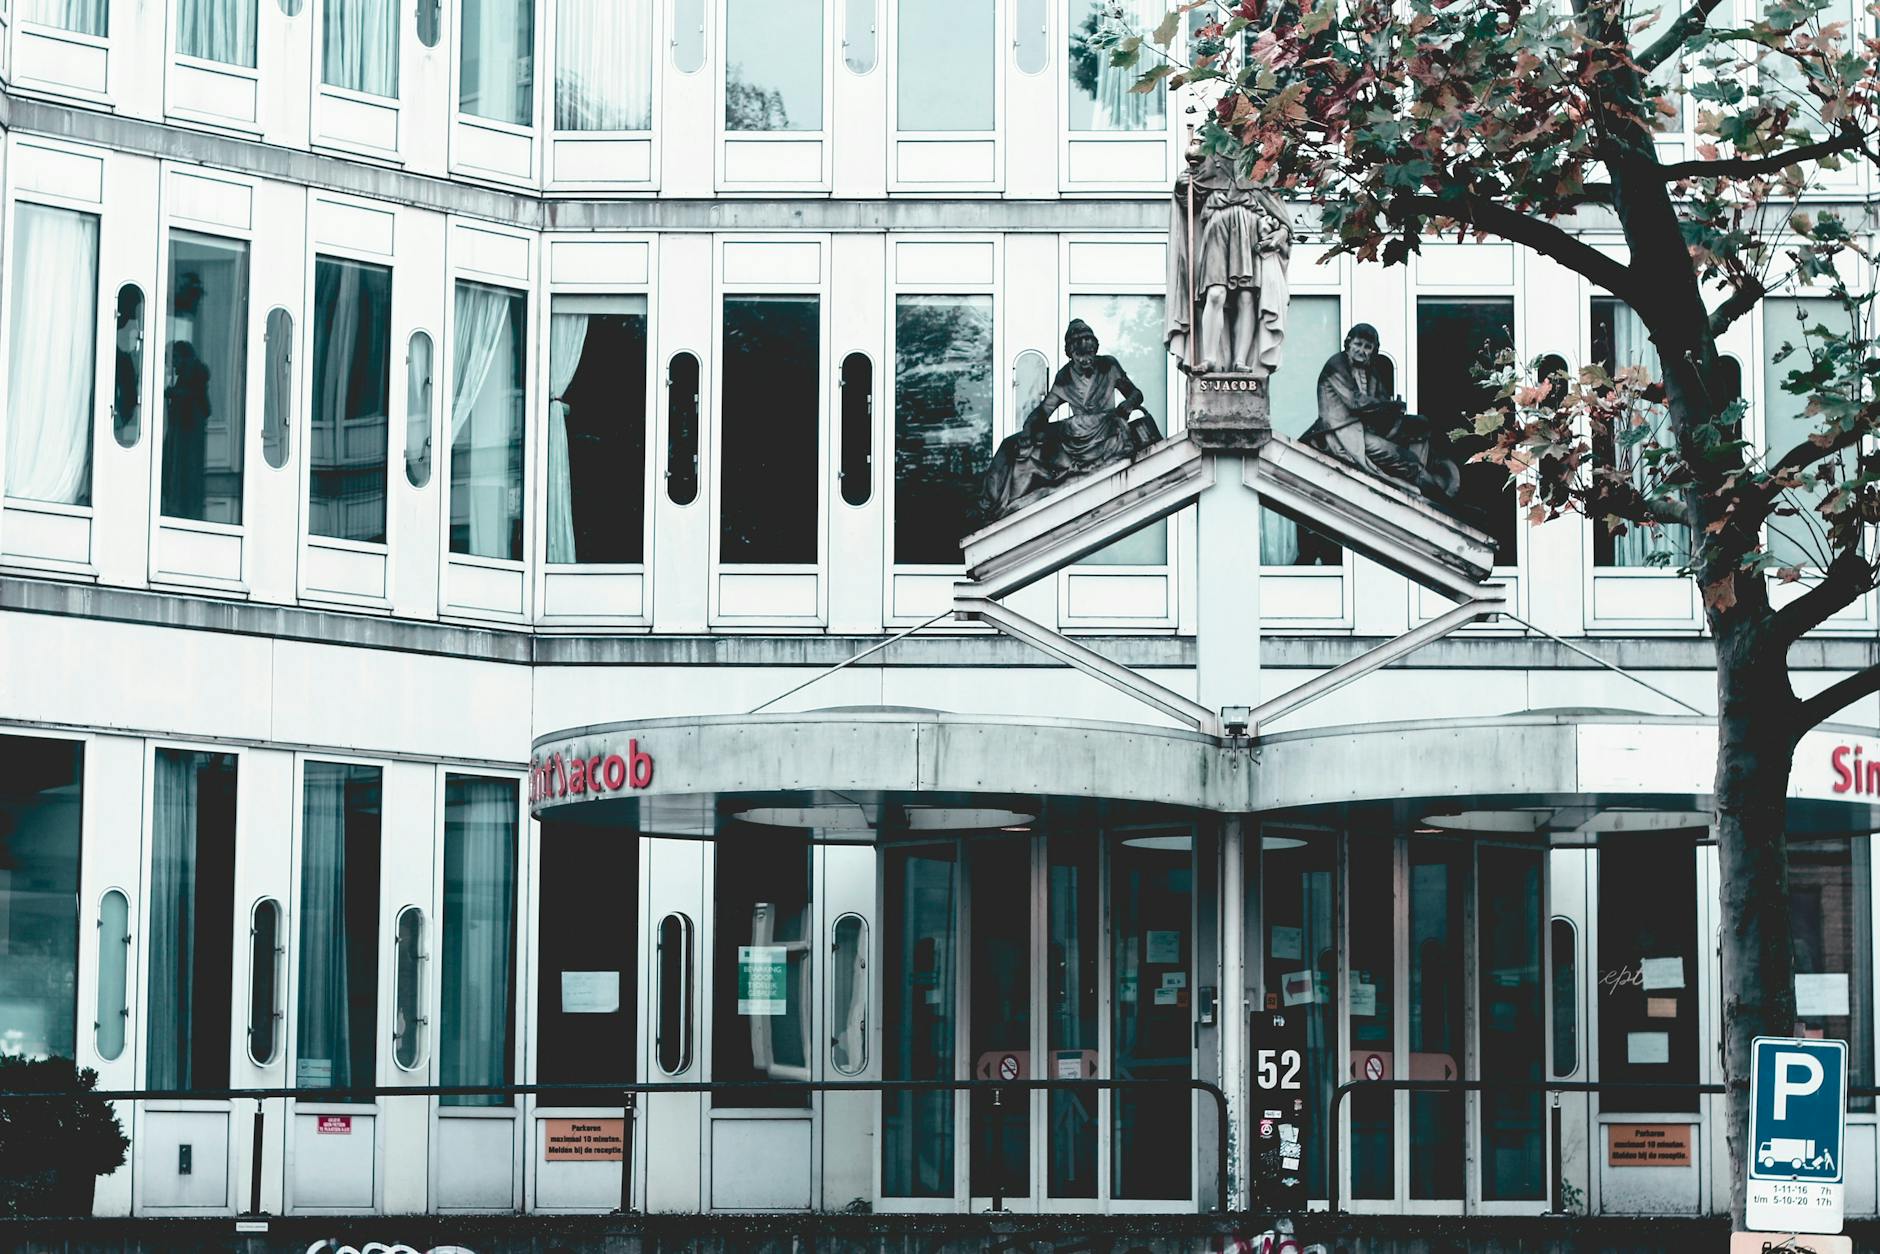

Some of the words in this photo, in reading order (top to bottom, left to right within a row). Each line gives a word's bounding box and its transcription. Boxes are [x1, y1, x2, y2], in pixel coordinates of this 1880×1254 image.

[1214, 380, 1257, 391] JACOB
[1257, 1050, 1301, 1090] 52
[1773, 1052, 1824, 1121] P
[571, 1124, 602, 1132] Parkeren
[550, 1135, 582, 1143] maximaal
[548, 1146, 573, 1154] Melden
[574, 1146, 583, 1155] bij
[584, 1146, 592, 1154] de
[1773, 1184, 1808, 1195] 1-11-'16
[1820, 1186, 1832, 1196] 7h
[1754, 1195, 1768, 1204] t/m
[1773, 1196, 1808, 1206] 5-10-'20
[1816, 1197, 1832, 1207] 17h
